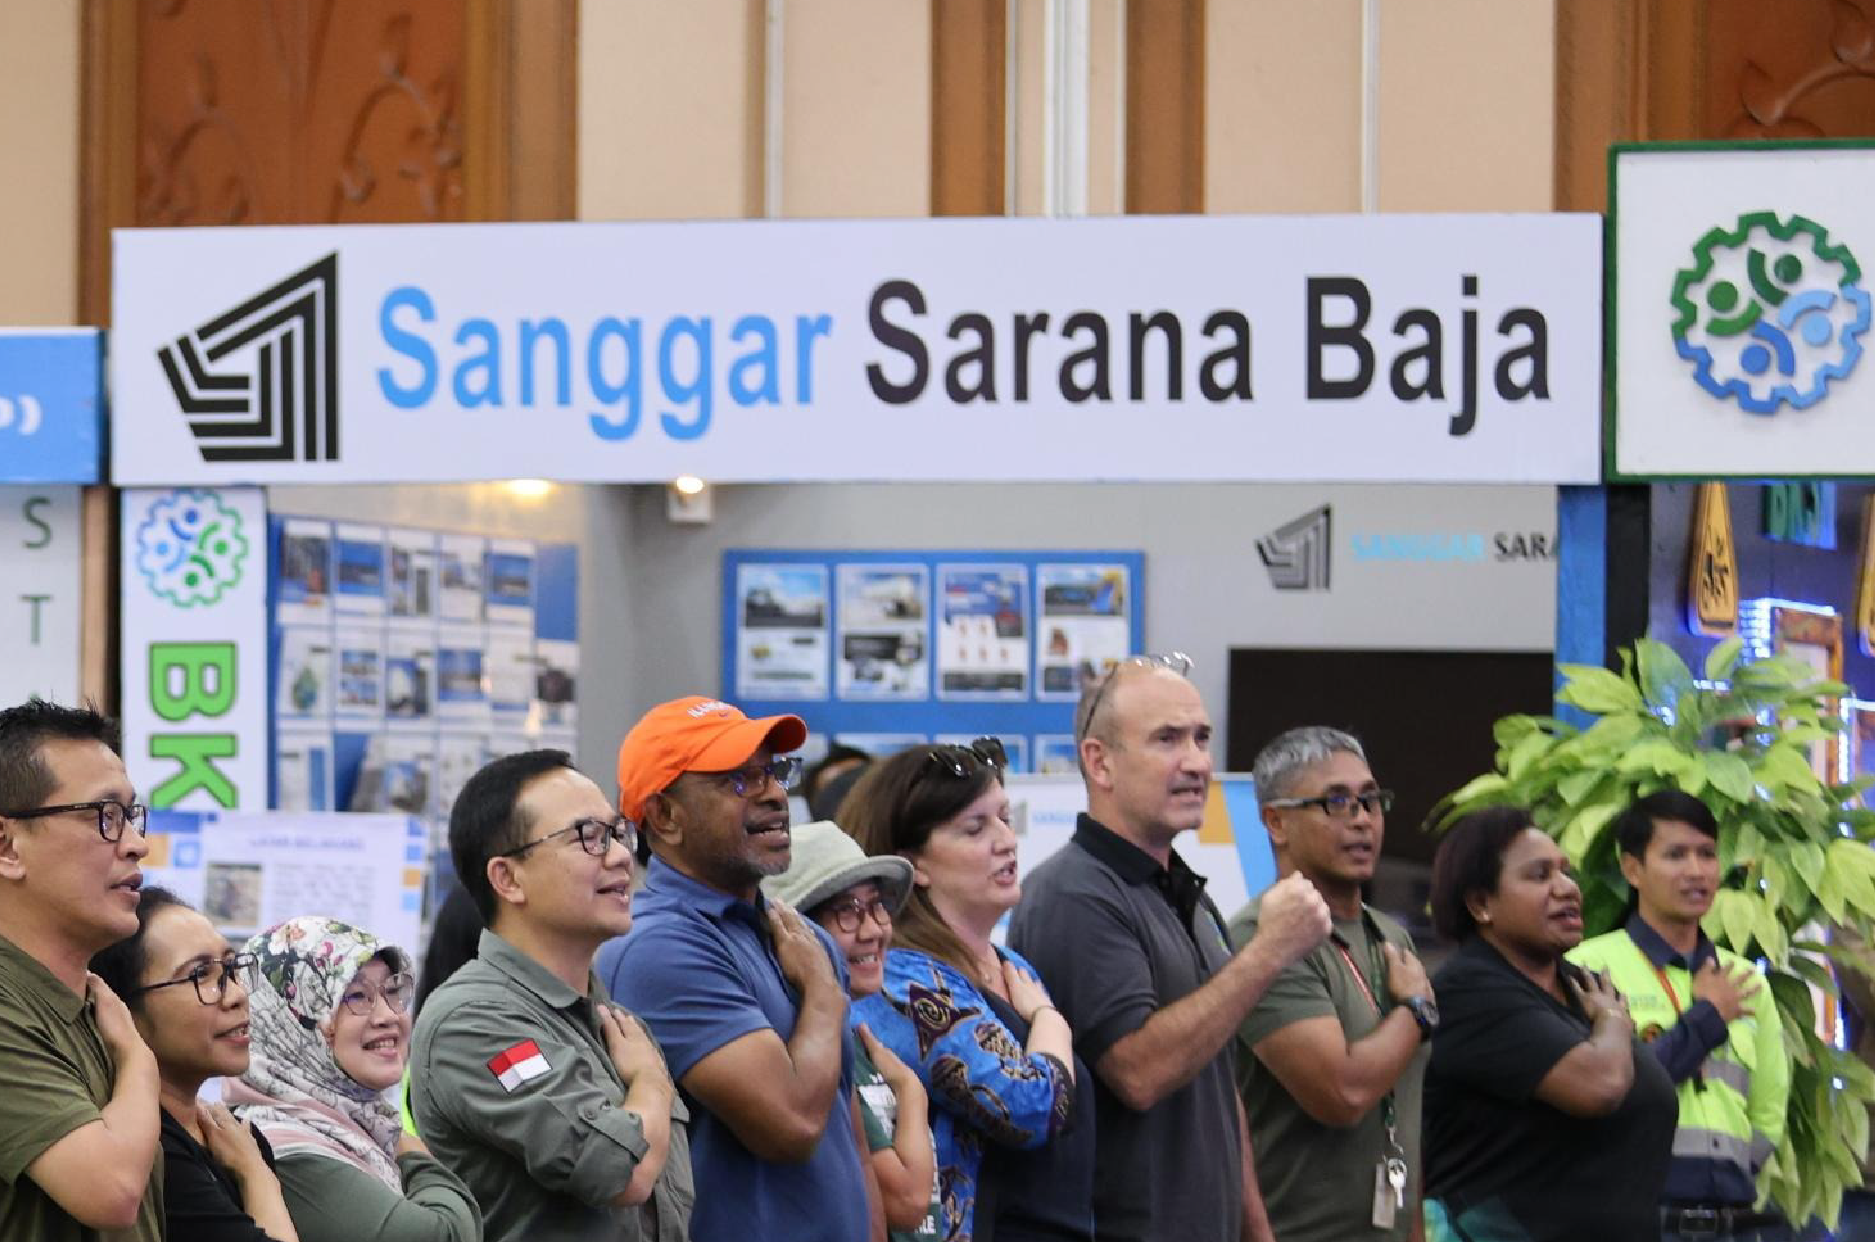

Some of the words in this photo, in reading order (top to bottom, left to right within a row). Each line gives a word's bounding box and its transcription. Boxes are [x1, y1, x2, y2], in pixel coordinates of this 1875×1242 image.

[377, 285, 832, 441] Sanggar
[866, 278, 1253, 405] Sarana
[1305, 274, 1550, 437] Baja
